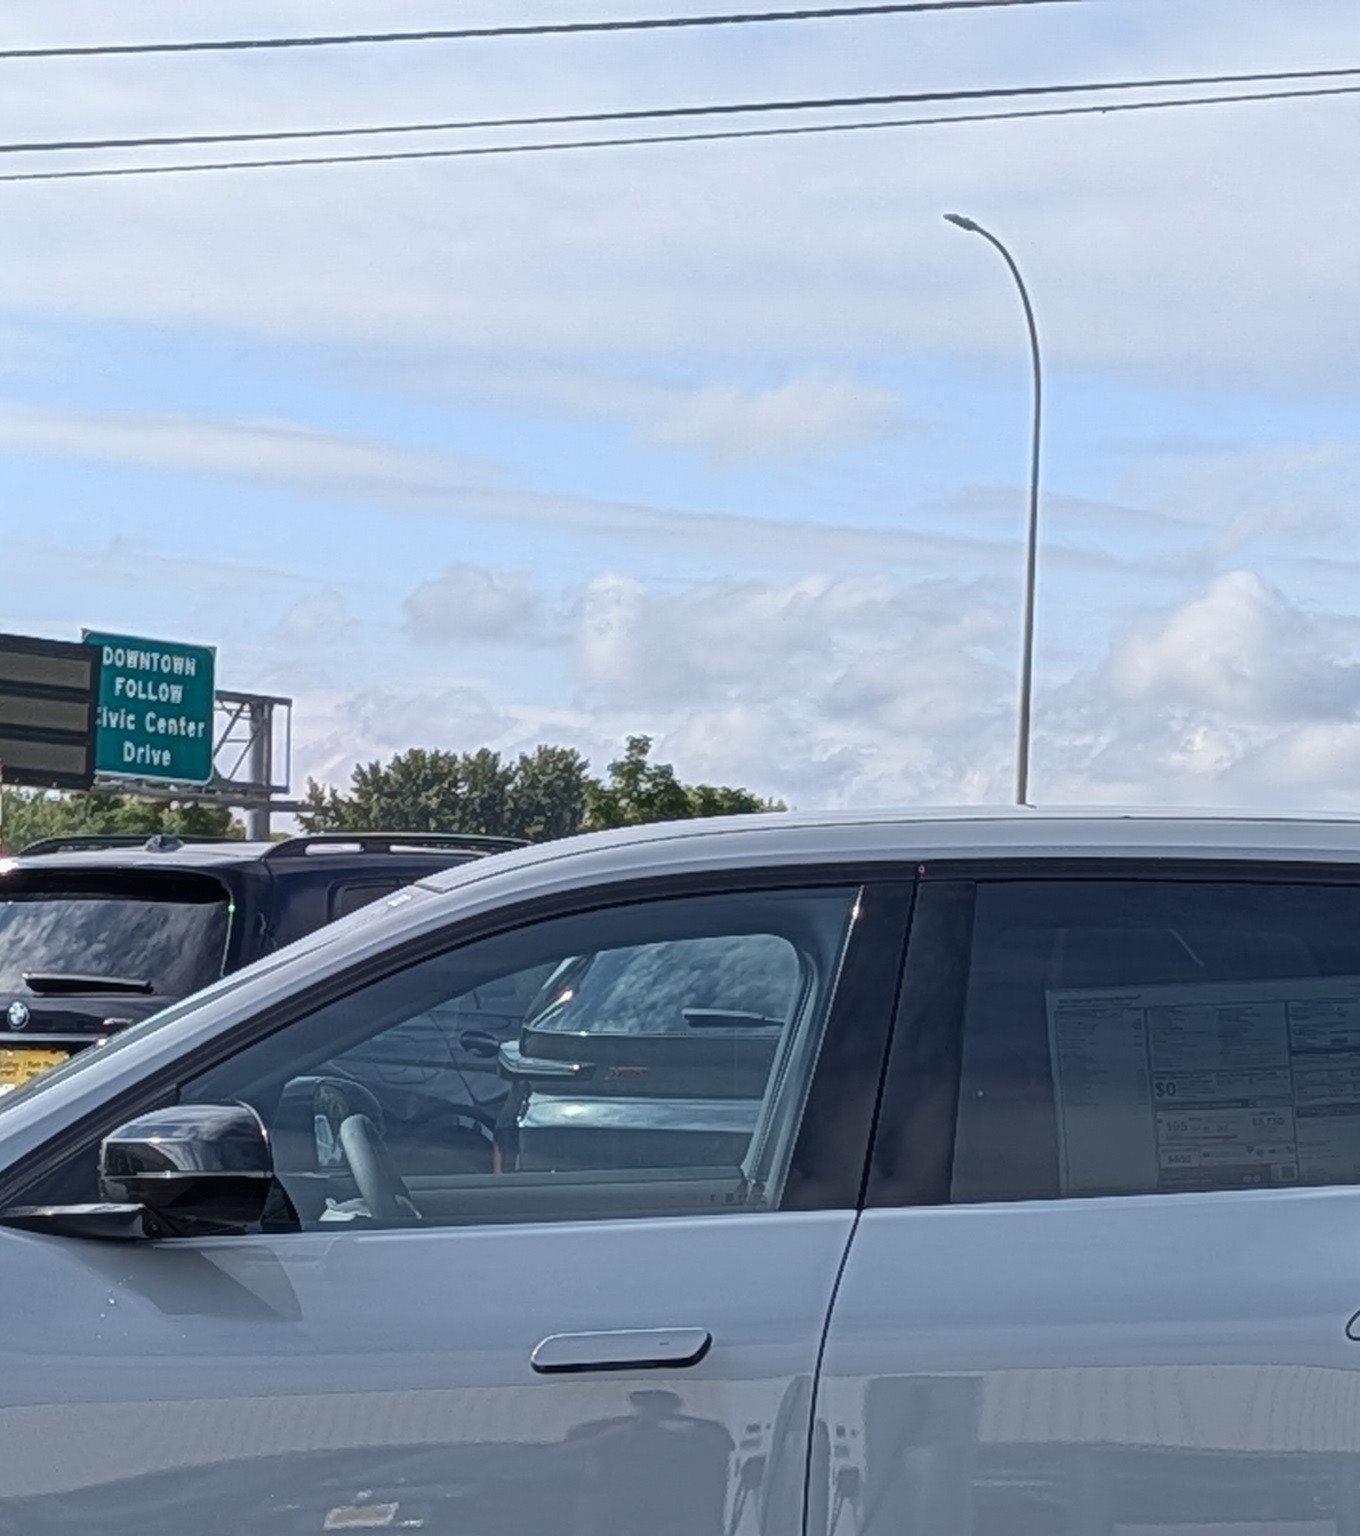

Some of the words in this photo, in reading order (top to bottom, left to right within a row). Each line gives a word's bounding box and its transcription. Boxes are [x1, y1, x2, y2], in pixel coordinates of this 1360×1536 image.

[102, 645, 196, 676] DOWNTOWN
[114, 676, 183, 704] FOLLOW
[145, 711, 205, 738] Center
[123, 740, 171, 767] Drive
